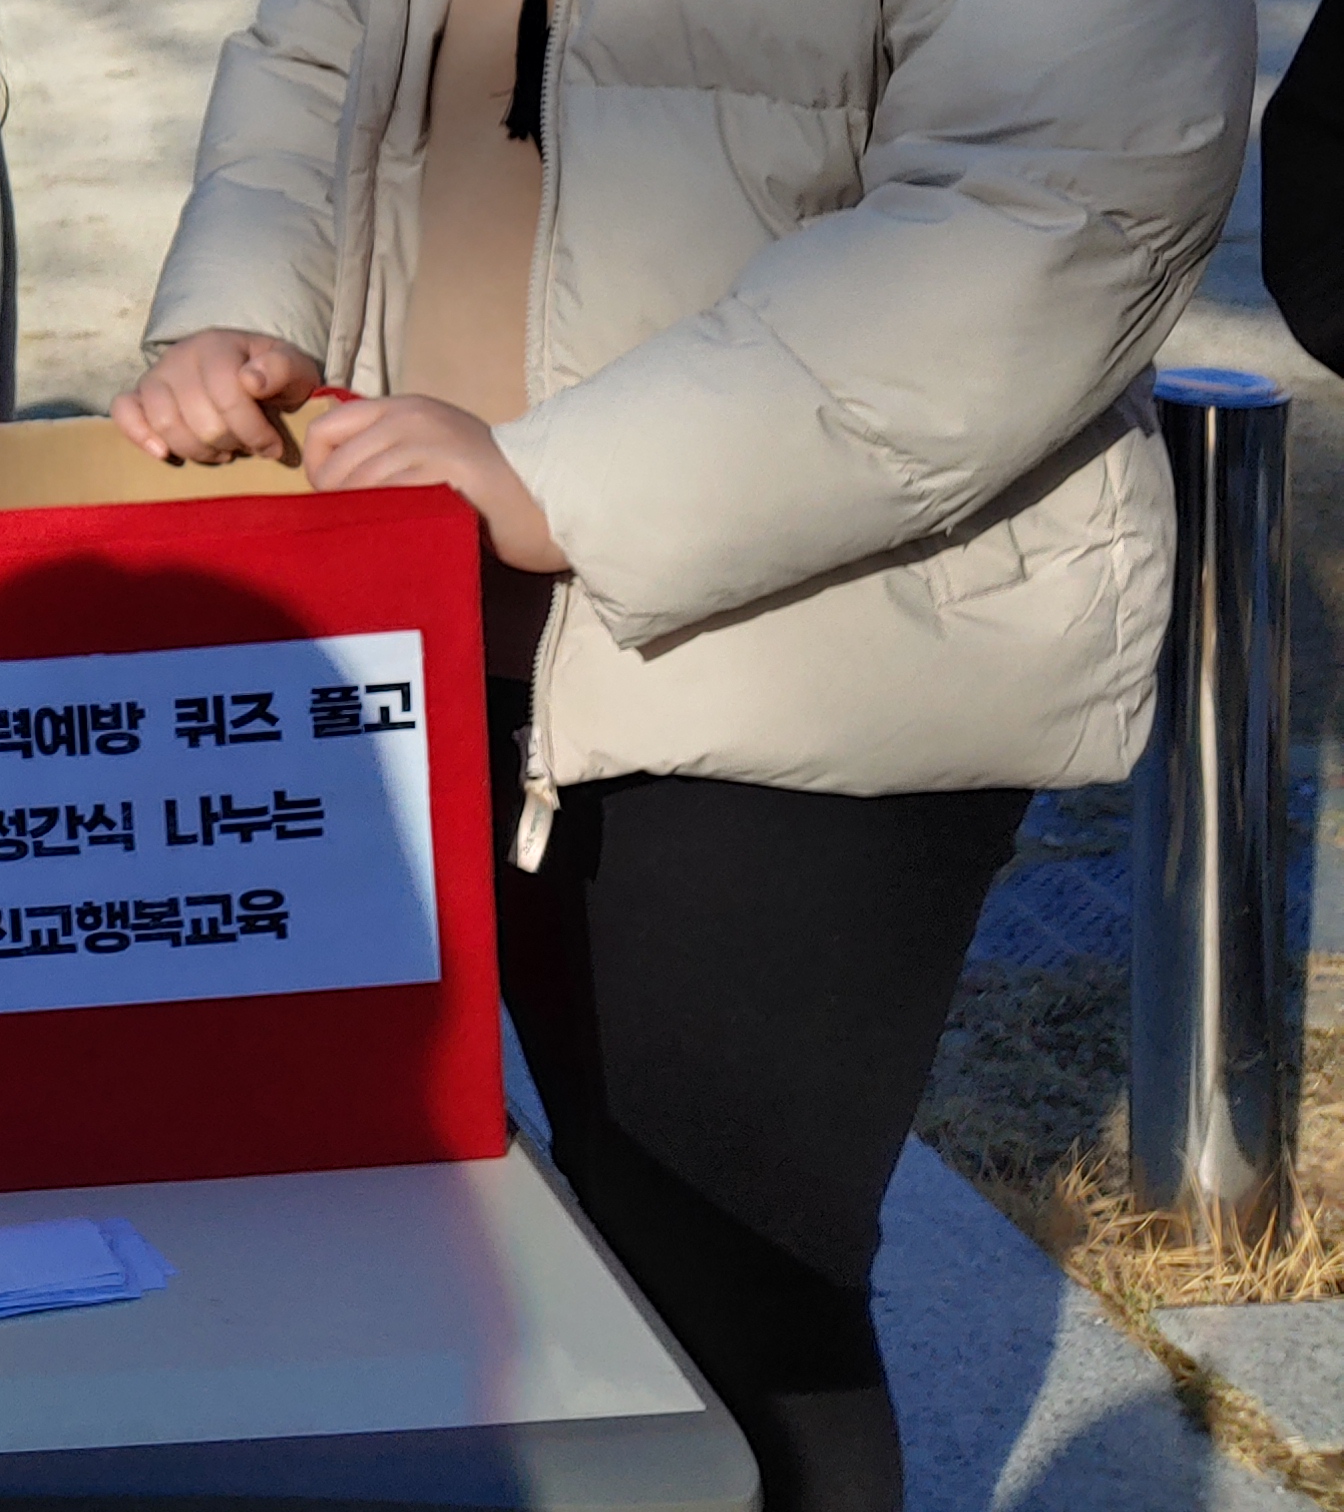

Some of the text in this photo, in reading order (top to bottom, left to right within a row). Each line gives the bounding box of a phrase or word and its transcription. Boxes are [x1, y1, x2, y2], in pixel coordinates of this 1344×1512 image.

[174, 692, 282, 748] 퀴즈
[309, 682, 416, 739] 풀고
[164, 790, 325, 846] 나누는
